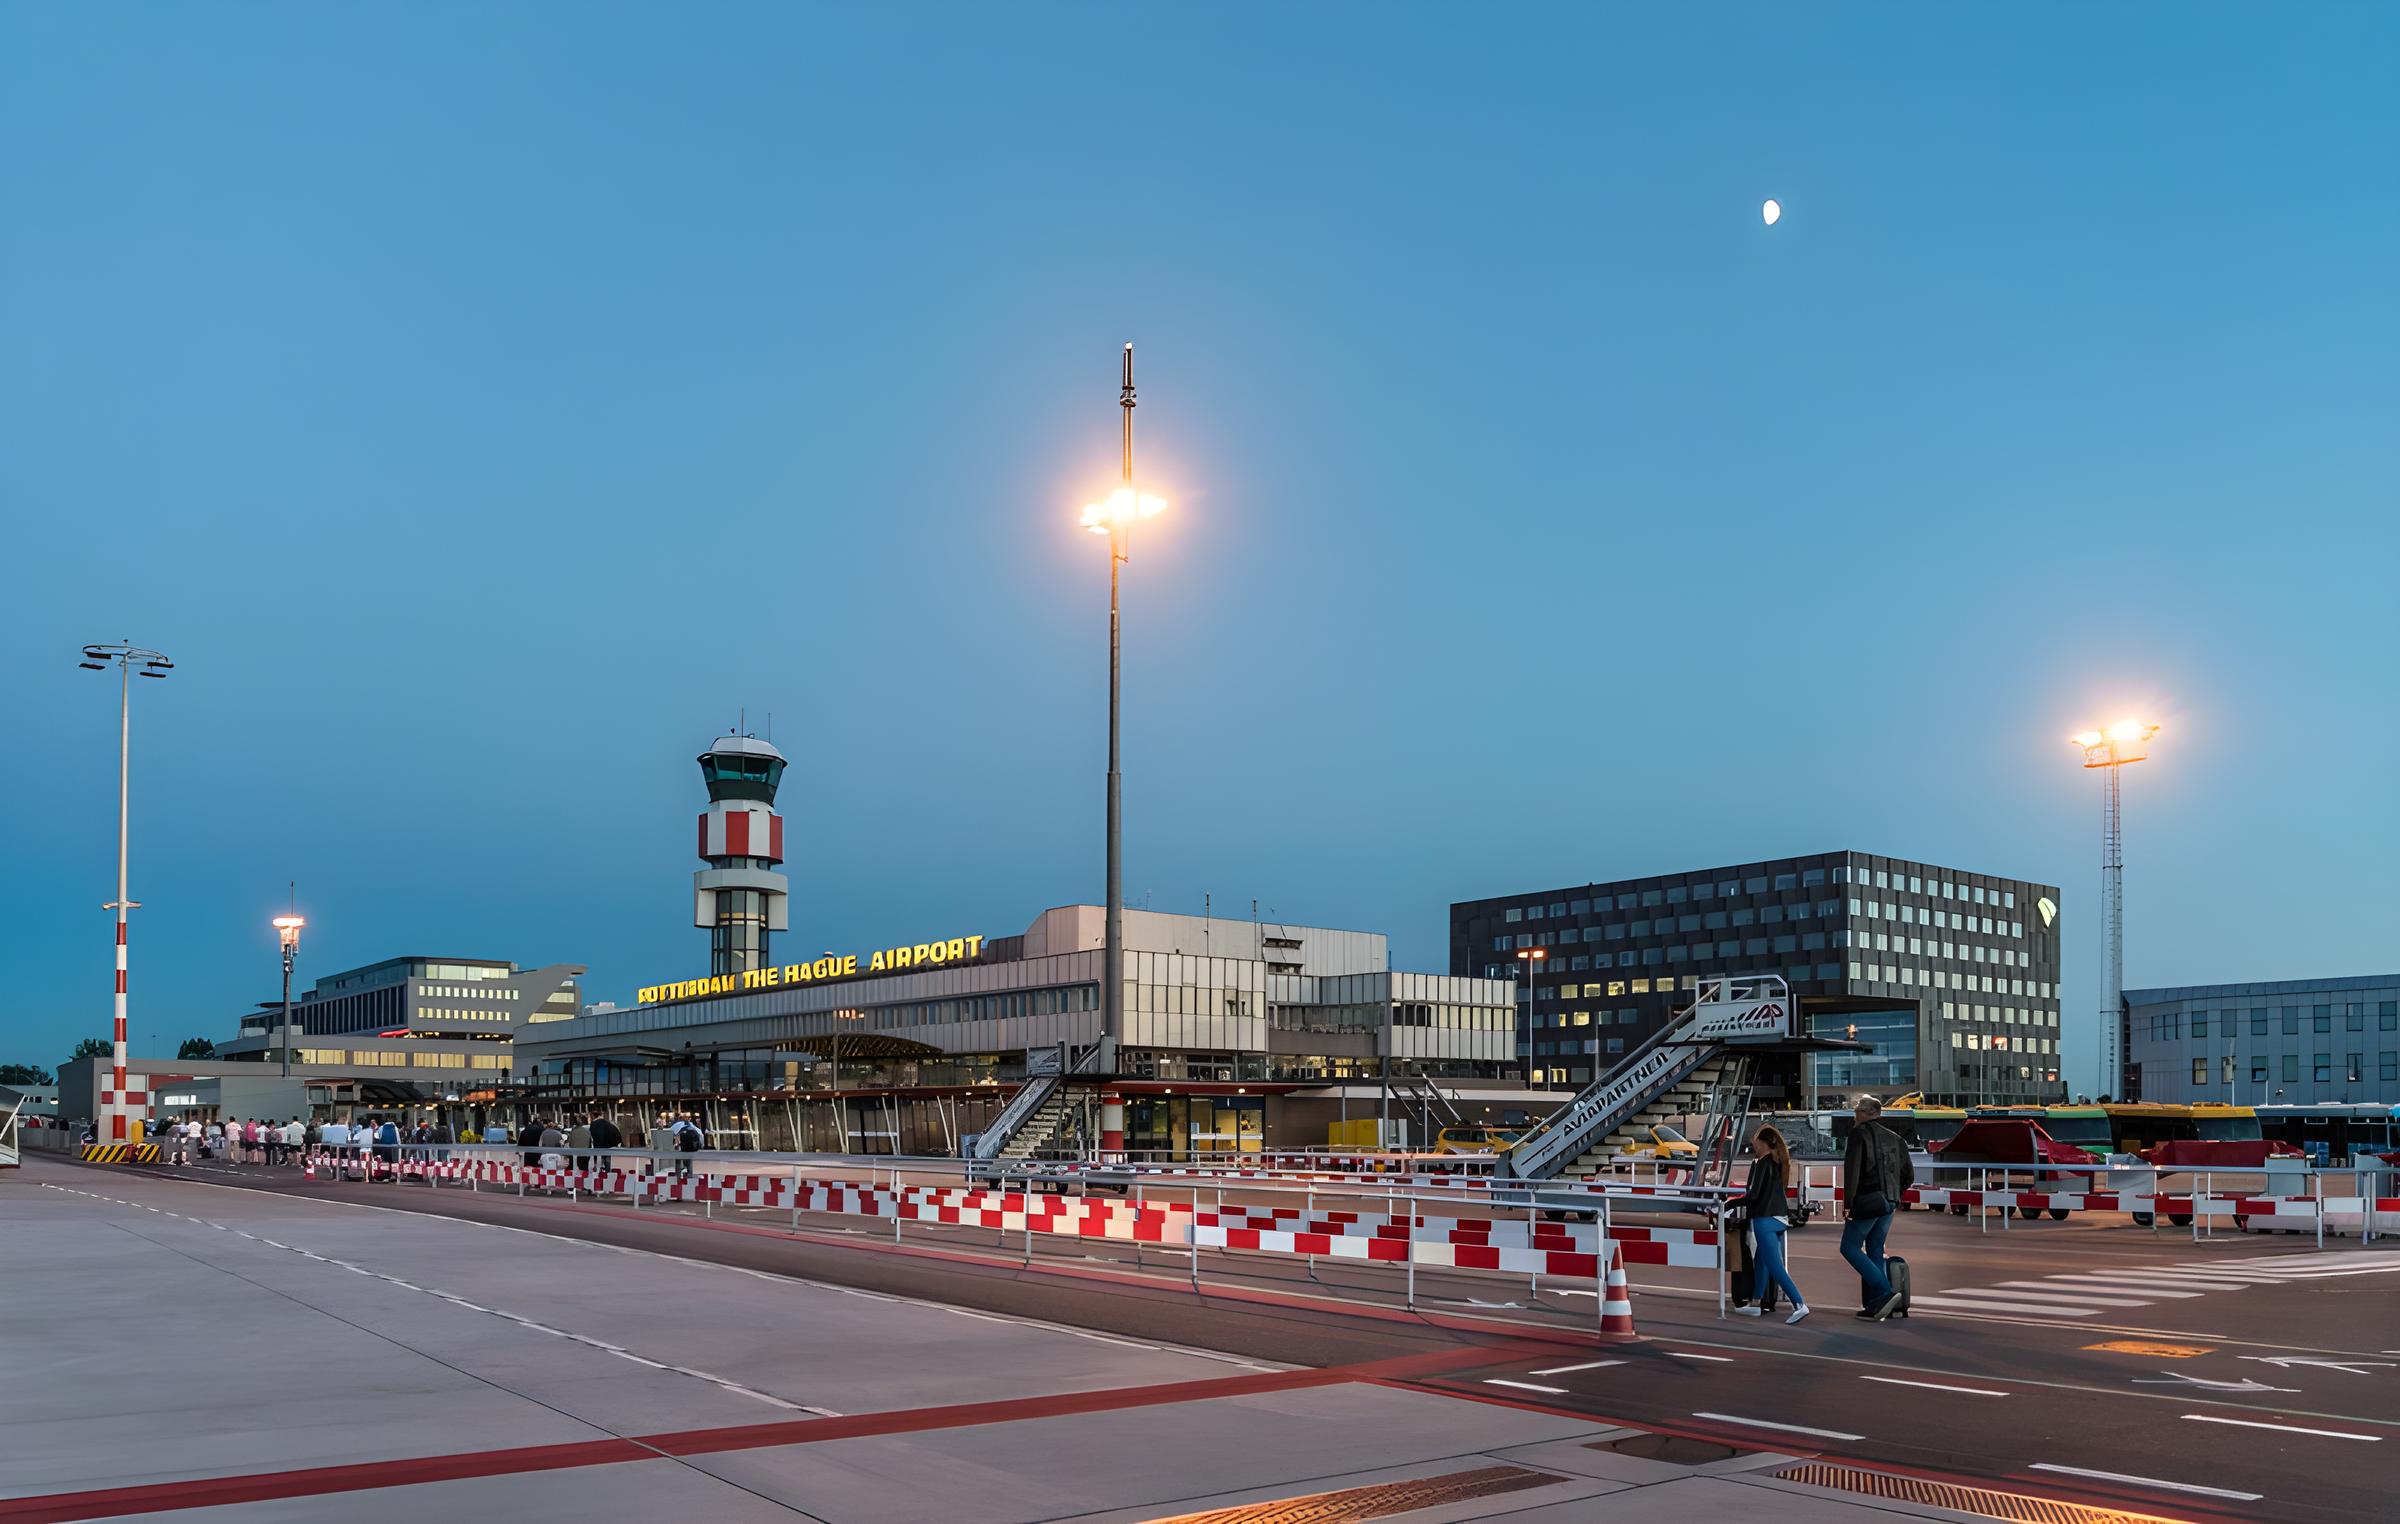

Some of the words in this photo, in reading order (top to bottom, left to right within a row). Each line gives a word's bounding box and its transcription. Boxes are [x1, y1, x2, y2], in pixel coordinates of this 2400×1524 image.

[743, 967, 778, 988] THE
[784, 955, 857, 983] HAGUE
[870, 935, 983, 971] AIRPORT
